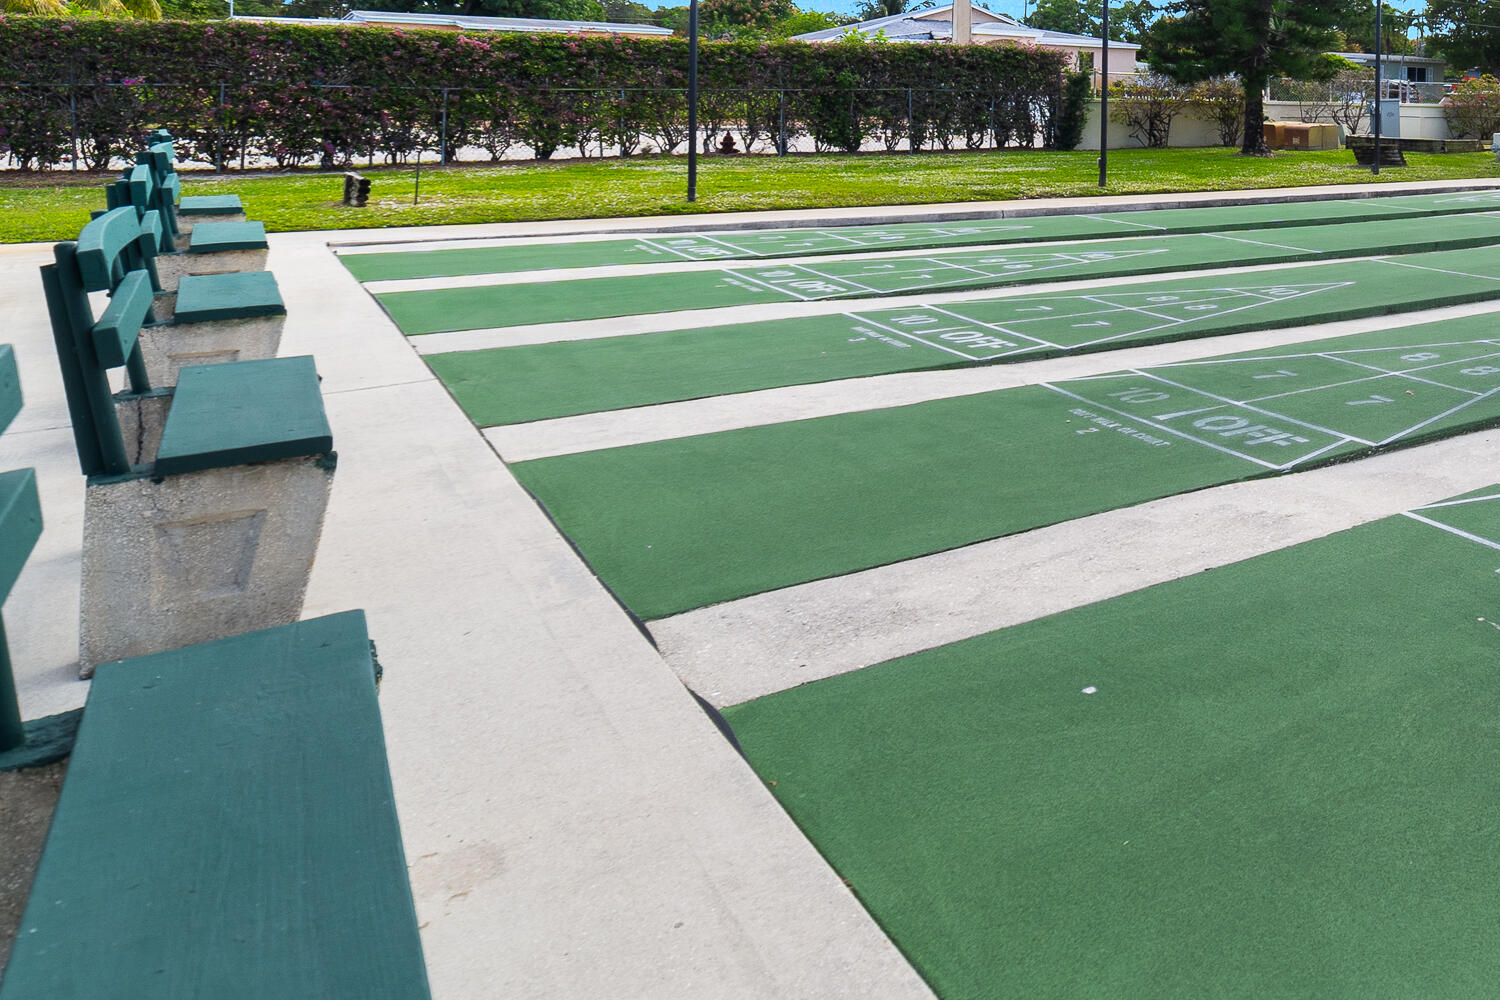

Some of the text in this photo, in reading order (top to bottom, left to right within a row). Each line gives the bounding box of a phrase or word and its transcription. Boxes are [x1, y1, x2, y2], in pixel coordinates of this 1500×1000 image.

[939, 331, 1018, 349] OFF
[1400, 352, 1440, 362] 8
[1460, 365, 1500, 377] 8
[1107, 387, 1310, 447] 10 OFF
